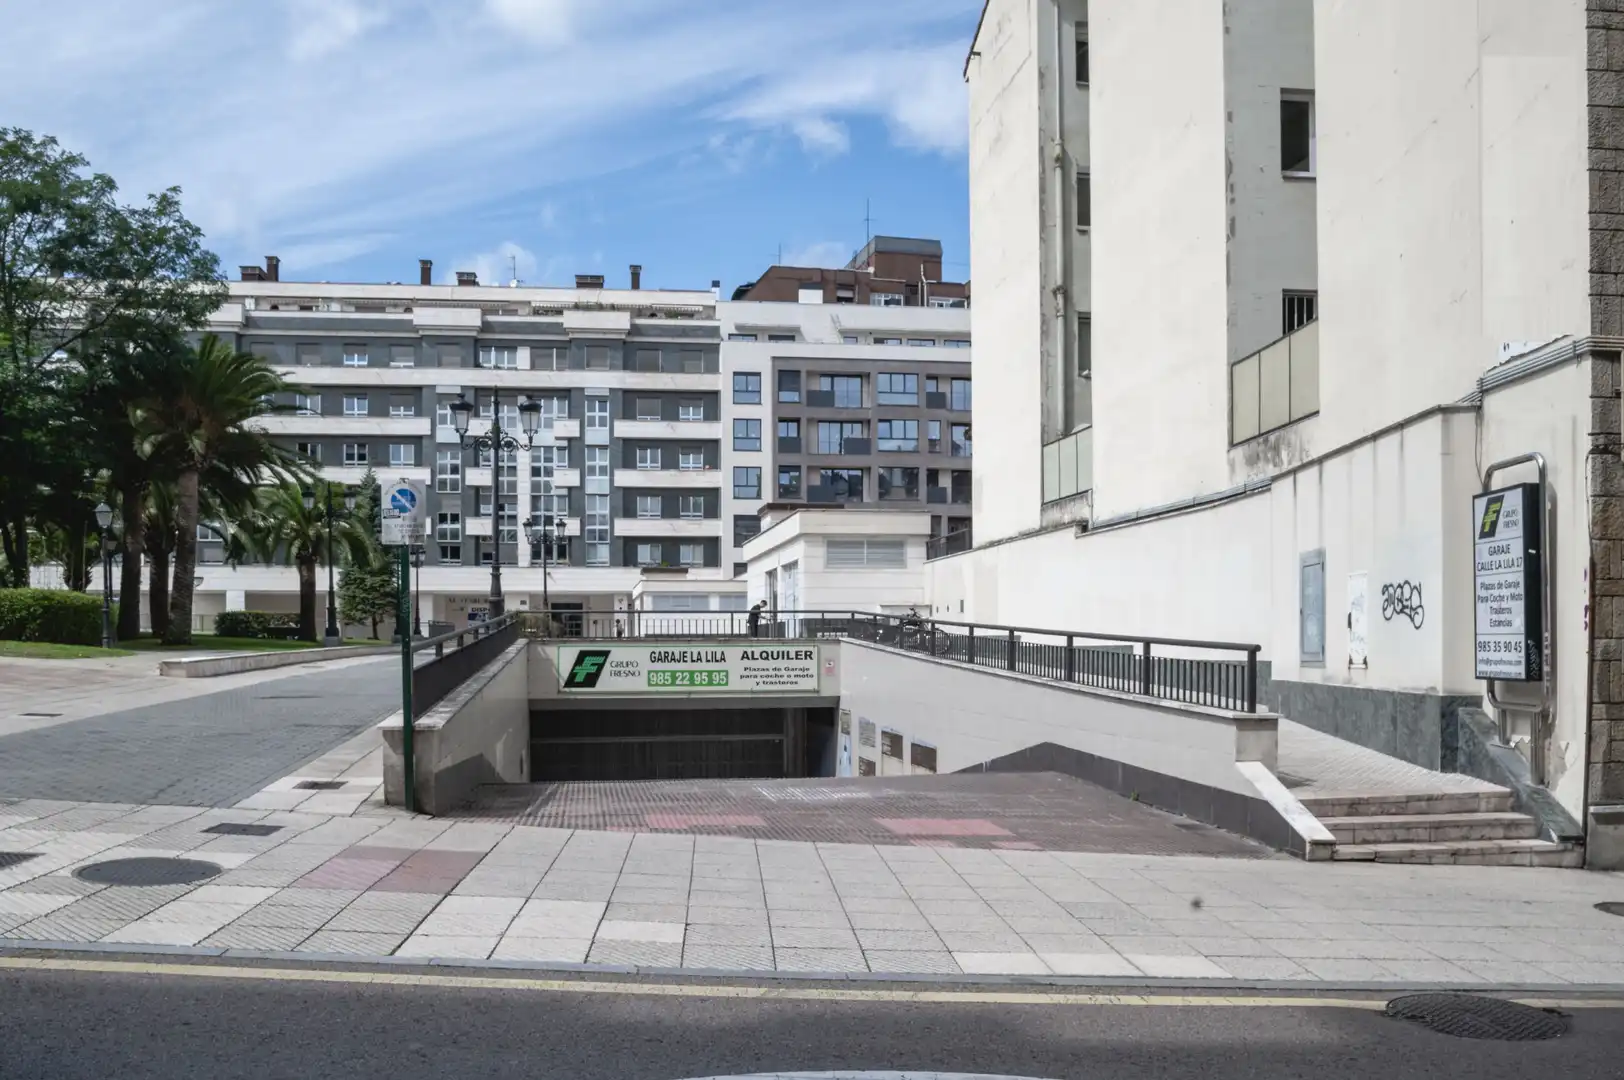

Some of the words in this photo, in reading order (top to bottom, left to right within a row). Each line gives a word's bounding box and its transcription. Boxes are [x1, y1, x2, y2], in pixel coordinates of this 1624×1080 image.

[1488, 544, 1511, 556] GARAJE
[1477, 560, 1494, 572] CALLE
[1495, 560, 1502, 570] LA
[1504, 557, 1515, 568] LILA
[1516, 556, 1522, 568] 17
[1480, 582, 1496, 590] Plazas
[1497, 580, 1504, 589] de
[1504, 580, 1520, 590] Garaje
[1478, 595, 1488, 603] Para
[1490, 594, 1504, 603] Coche
[1510, 593, 1522, 601] Moto
[1490, 606, 1512, 614] Trasteros
[1490, 618, 1512, 628] Estancias
[1478, 641, 1491, 652] 985
[1493, 641, 1501, 652] 35
[1504, 641, 1512, 652] 90
[1514, 641, 1522, 653] 45
[650, 650, 688, 663] GARAJE
[690, 650, 702, 662] LA
[705, 650, 726, 662] LILA
[740, 650, 813, 661] ALQUILER
[610, 660, 638, 668] GRUPO
[650, 672, 671, 684] 985
[676, 672, 690, 684] 22
[694, 672, 708, 684] 95
[712, 672, 726, 684] 95
